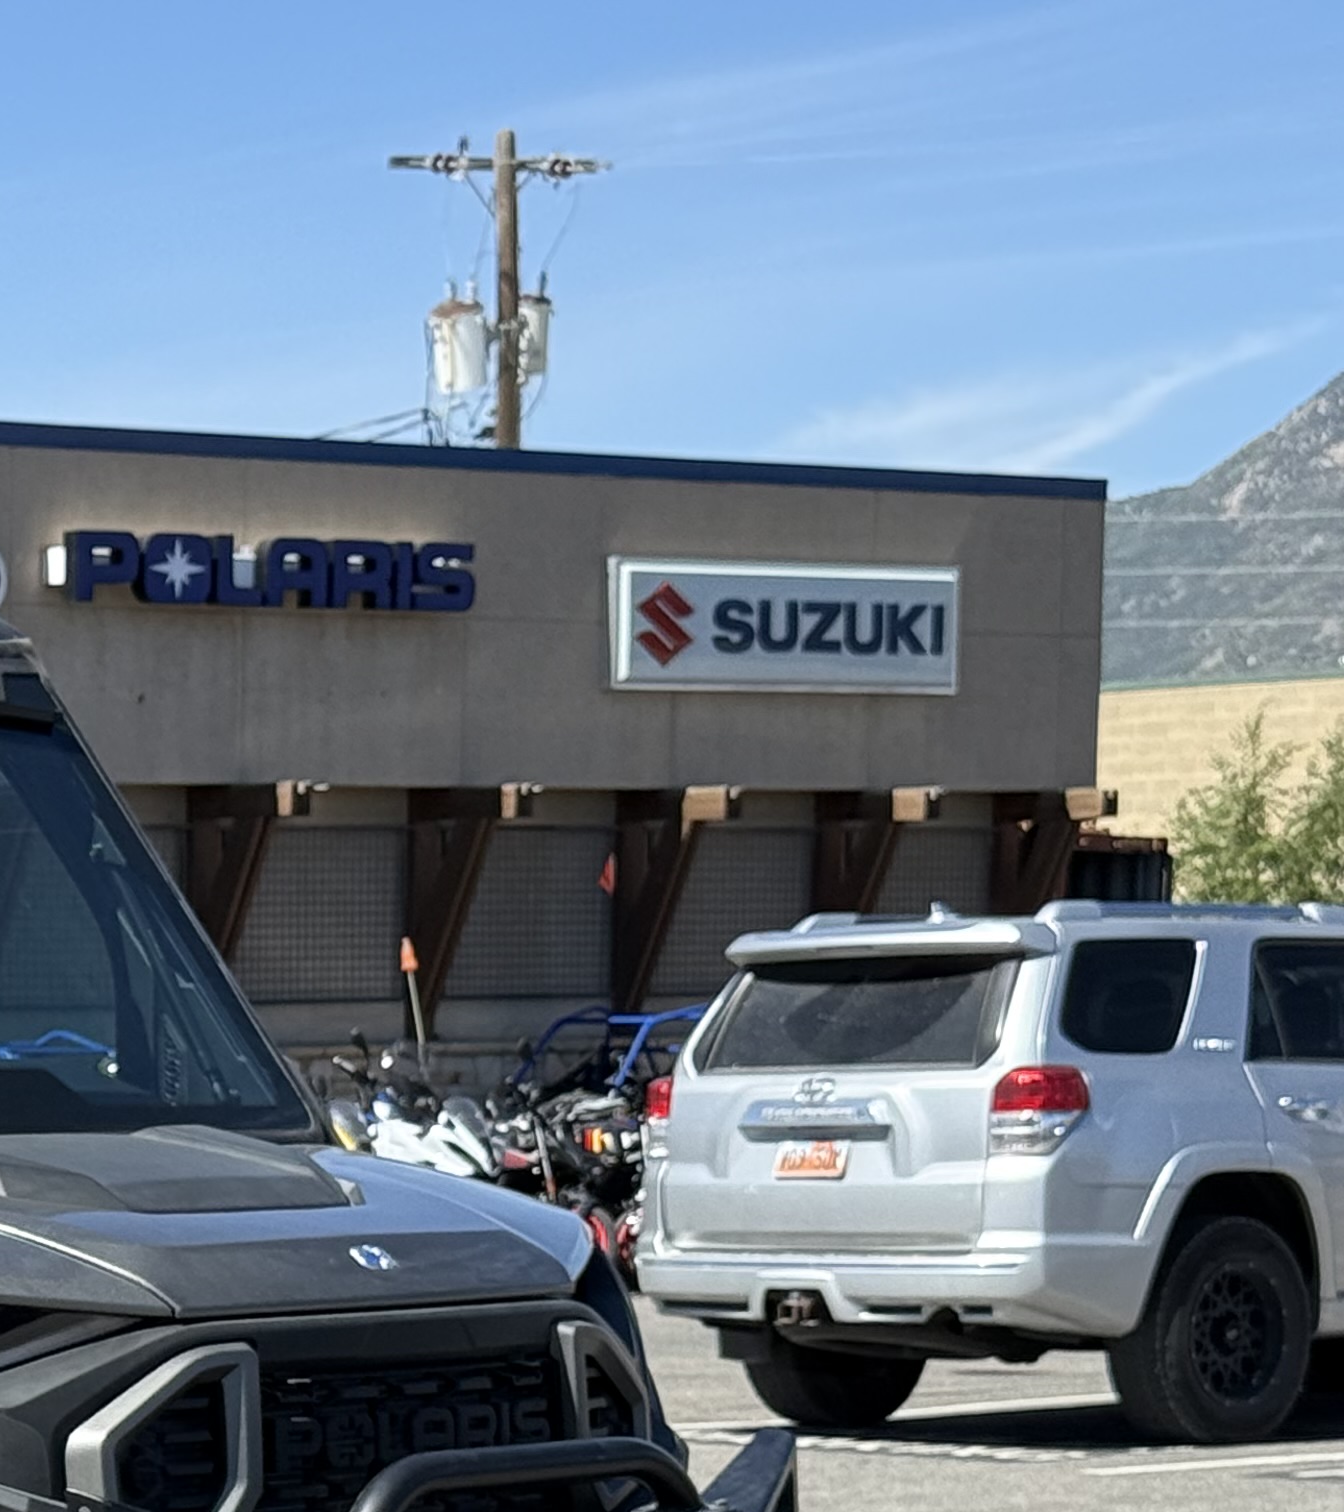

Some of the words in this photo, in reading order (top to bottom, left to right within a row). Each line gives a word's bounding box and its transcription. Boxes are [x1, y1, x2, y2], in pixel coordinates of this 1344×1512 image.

[64, 530, 476, 612] POLARIS
[712, 598, 945, 656] SUZUKI
[274, 1397, 552, 1474] POLARIS
